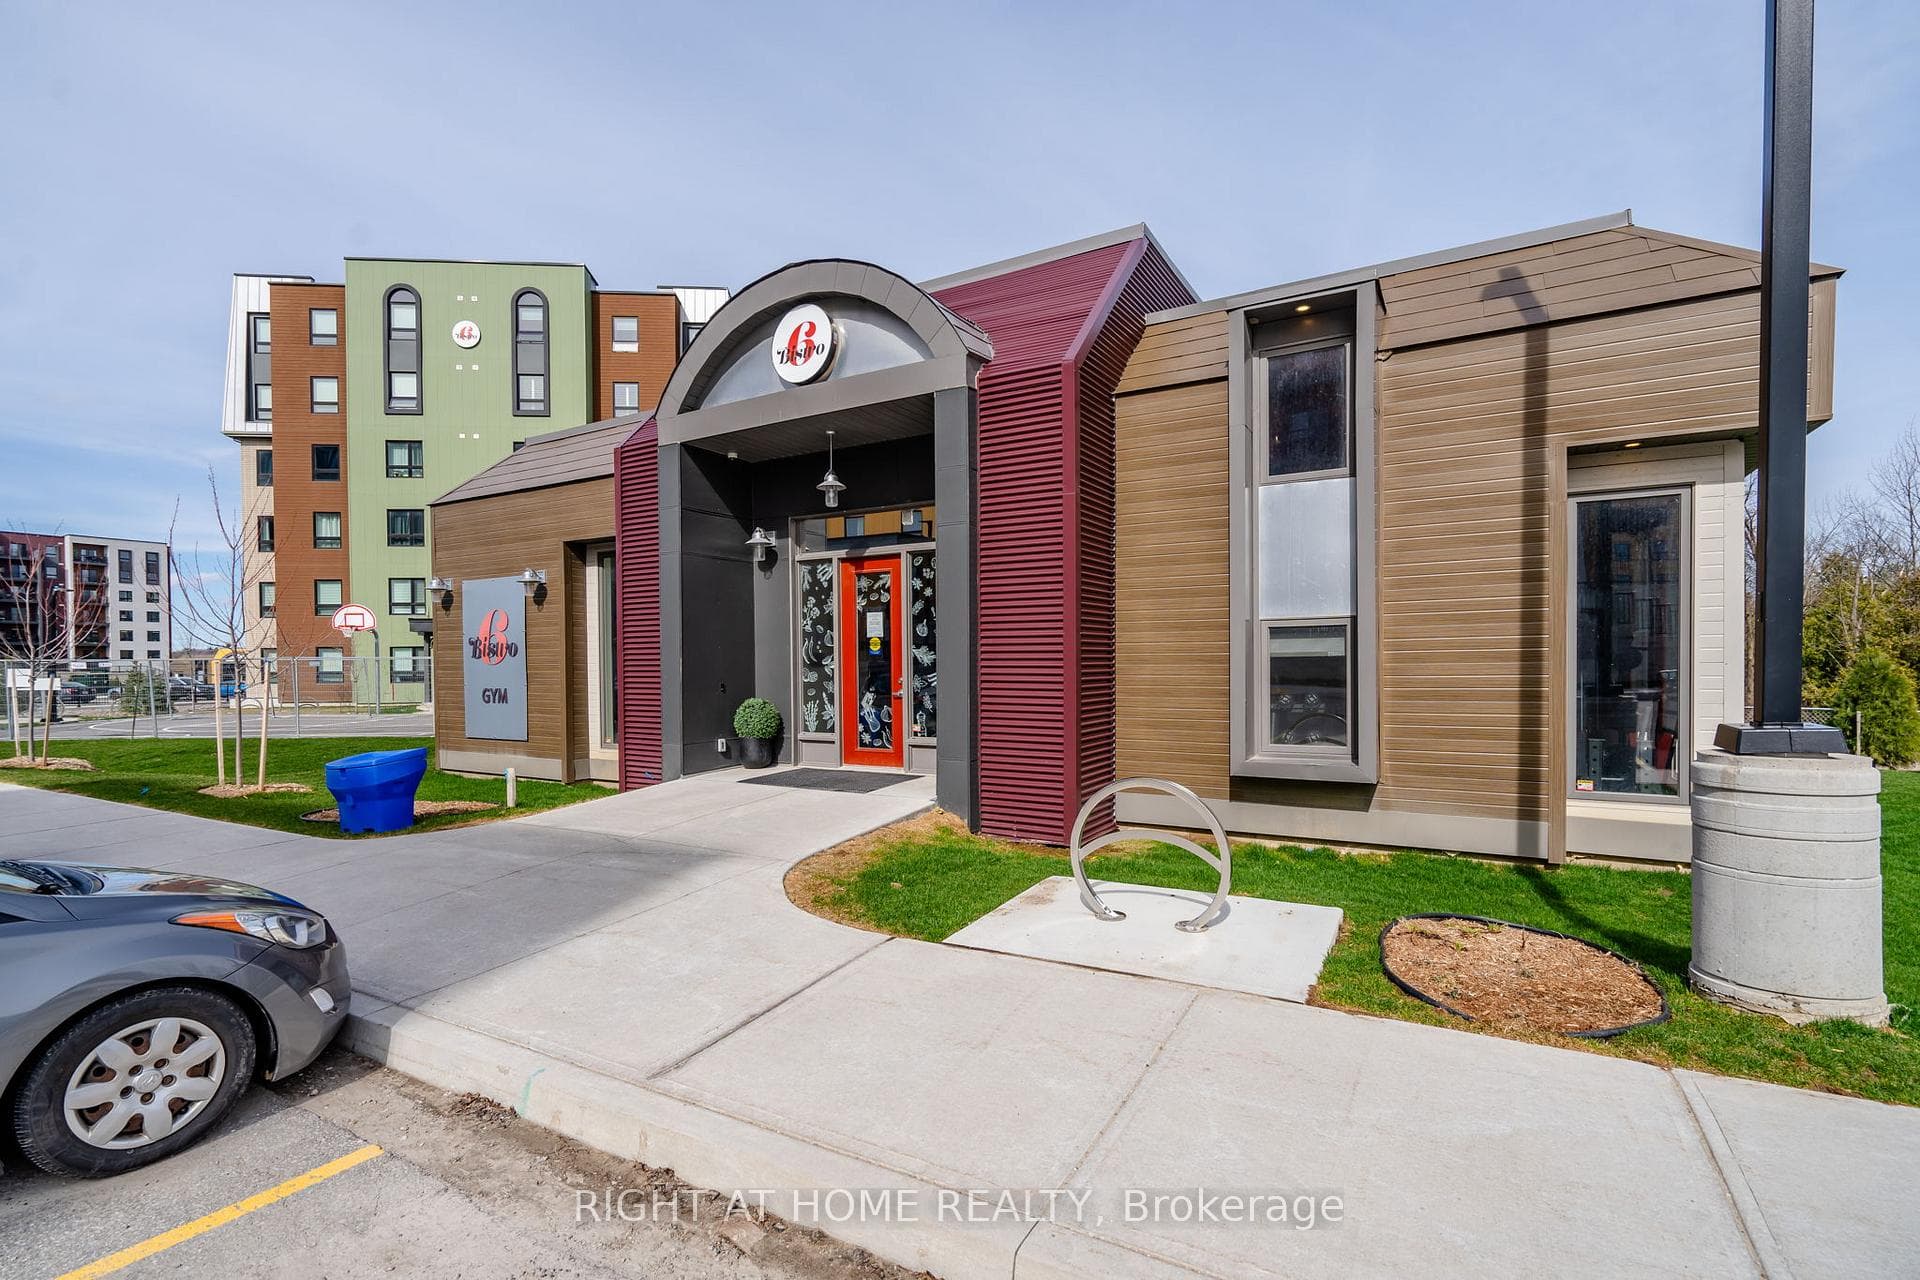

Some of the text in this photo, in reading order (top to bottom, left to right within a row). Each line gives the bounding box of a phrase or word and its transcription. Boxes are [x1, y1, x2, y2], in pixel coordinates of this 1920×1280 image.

[787, 320, 817, 367] 6
[468, 636, 519, 660] Bistro
[479, 607, 509, 666] 6
[482, 687, 509, 705] GYM
